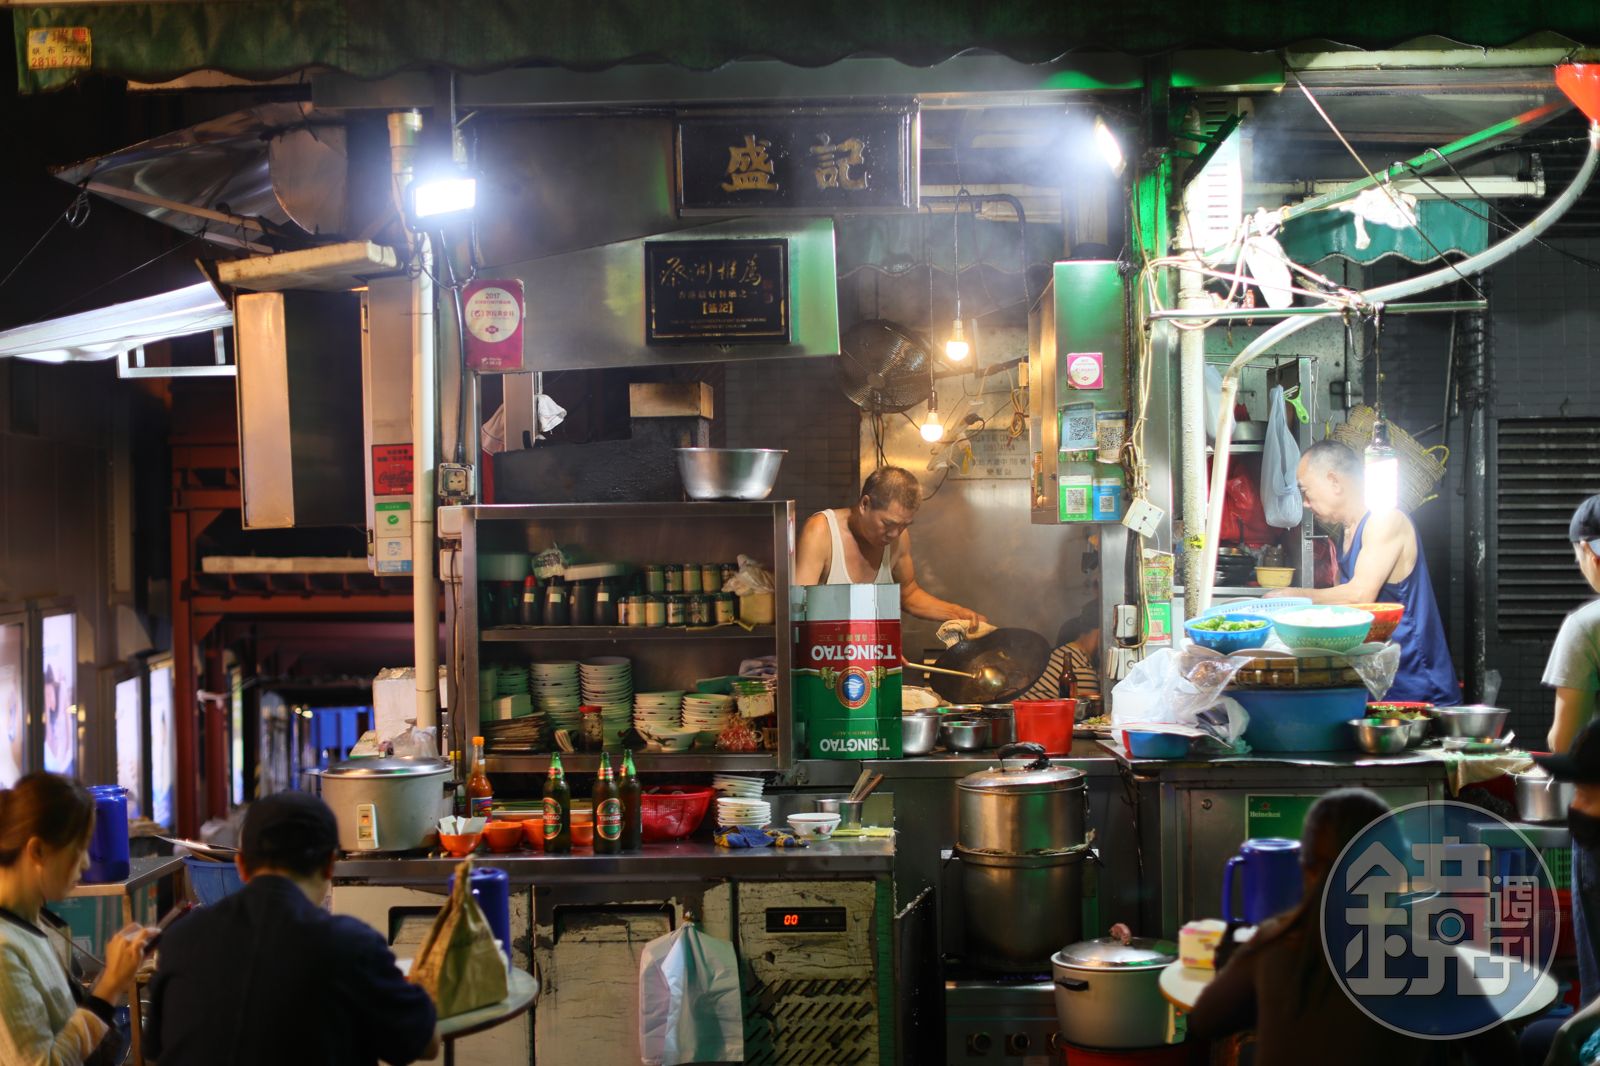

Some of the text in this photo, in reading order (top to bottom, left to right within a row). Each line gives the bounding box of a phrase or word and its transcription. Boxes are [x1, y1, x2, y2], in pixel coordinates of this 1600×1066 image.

[32, 57, 57, 67] 2816
[722, 133, 869, 191] 盛記
[811, 644, 897, 661] TSINGTAO
[819, 737, 890, 752] TSINGTAO
[783, 914, 799, 926] 00
